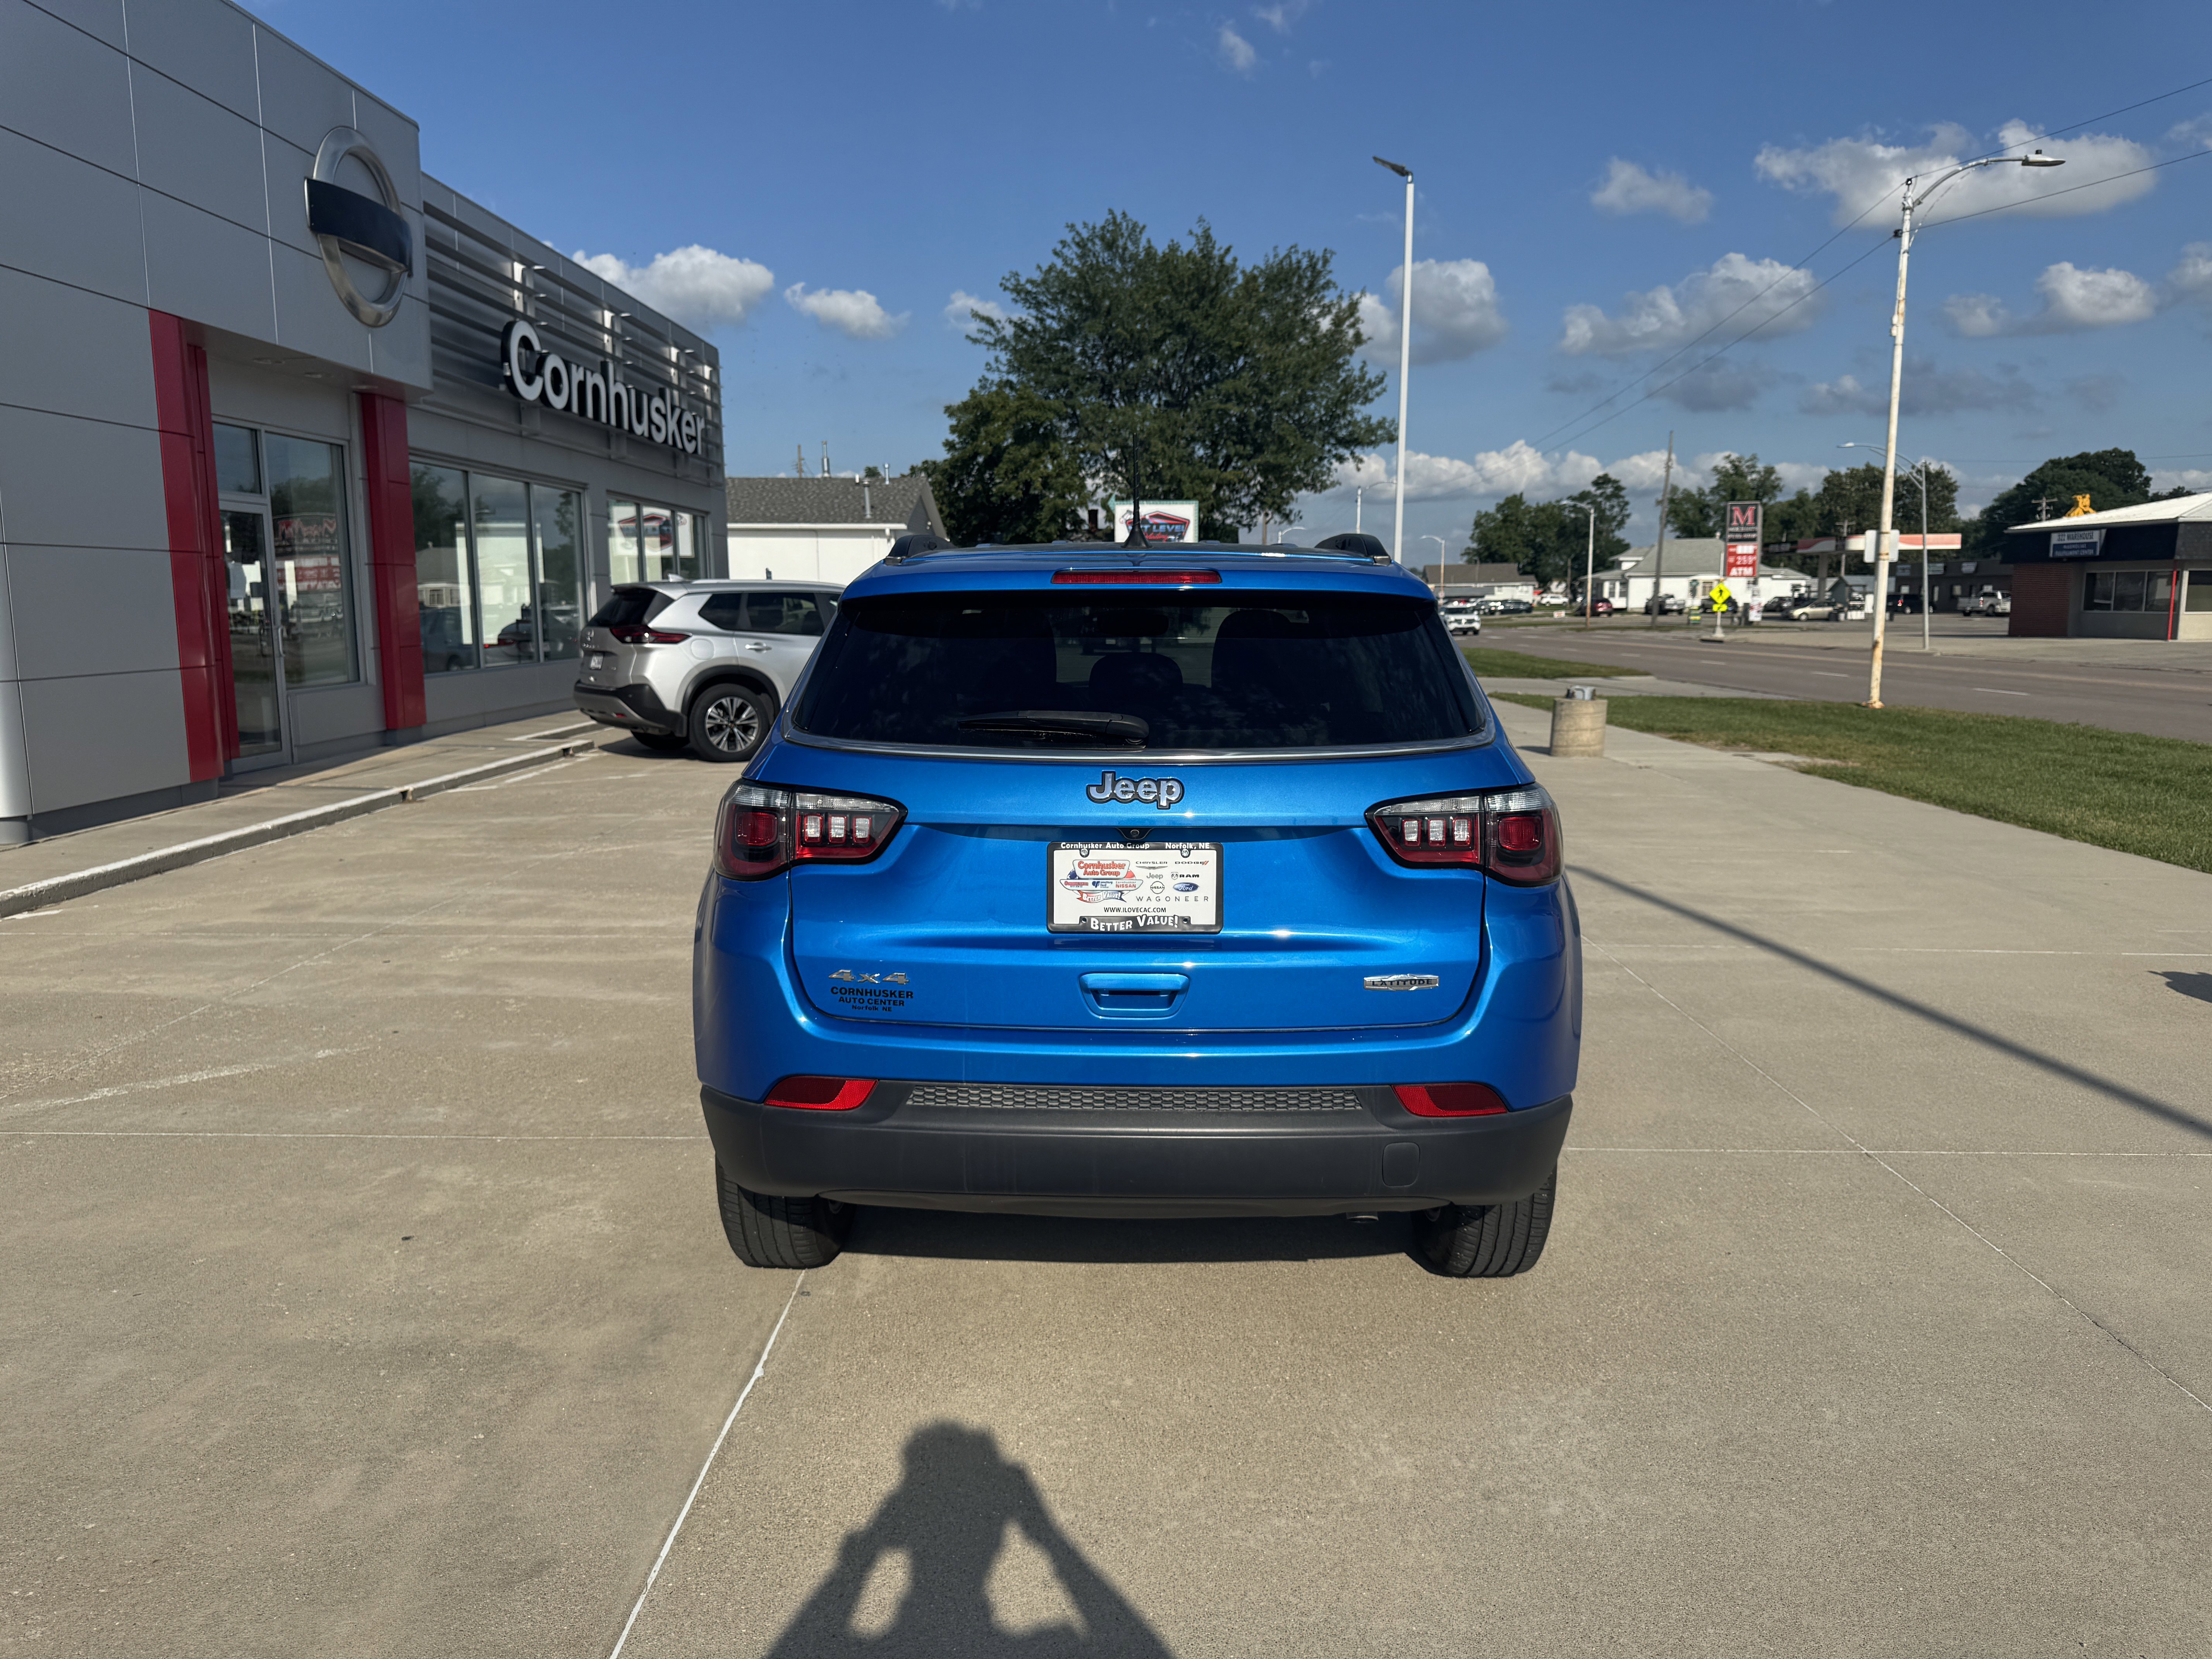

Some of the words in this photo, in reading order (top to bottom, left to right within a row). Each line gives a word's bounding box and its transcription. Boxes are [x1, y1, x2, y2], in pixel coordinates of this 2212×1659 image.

[503, 320, 705, 455] Cornhusker
[1732, 507, 1756, 526] M
[1729, 567, 1753, 576] ATM
[1087, 771, 1184, 809] Jeep
[1078, 861, 1126, 869] Cornhusker
[1091, 917, 1133, 931] BETTER
[1137, 914, 1178, 928] VALUE!
[831, 986, 914, 999] CORNHUSKER
